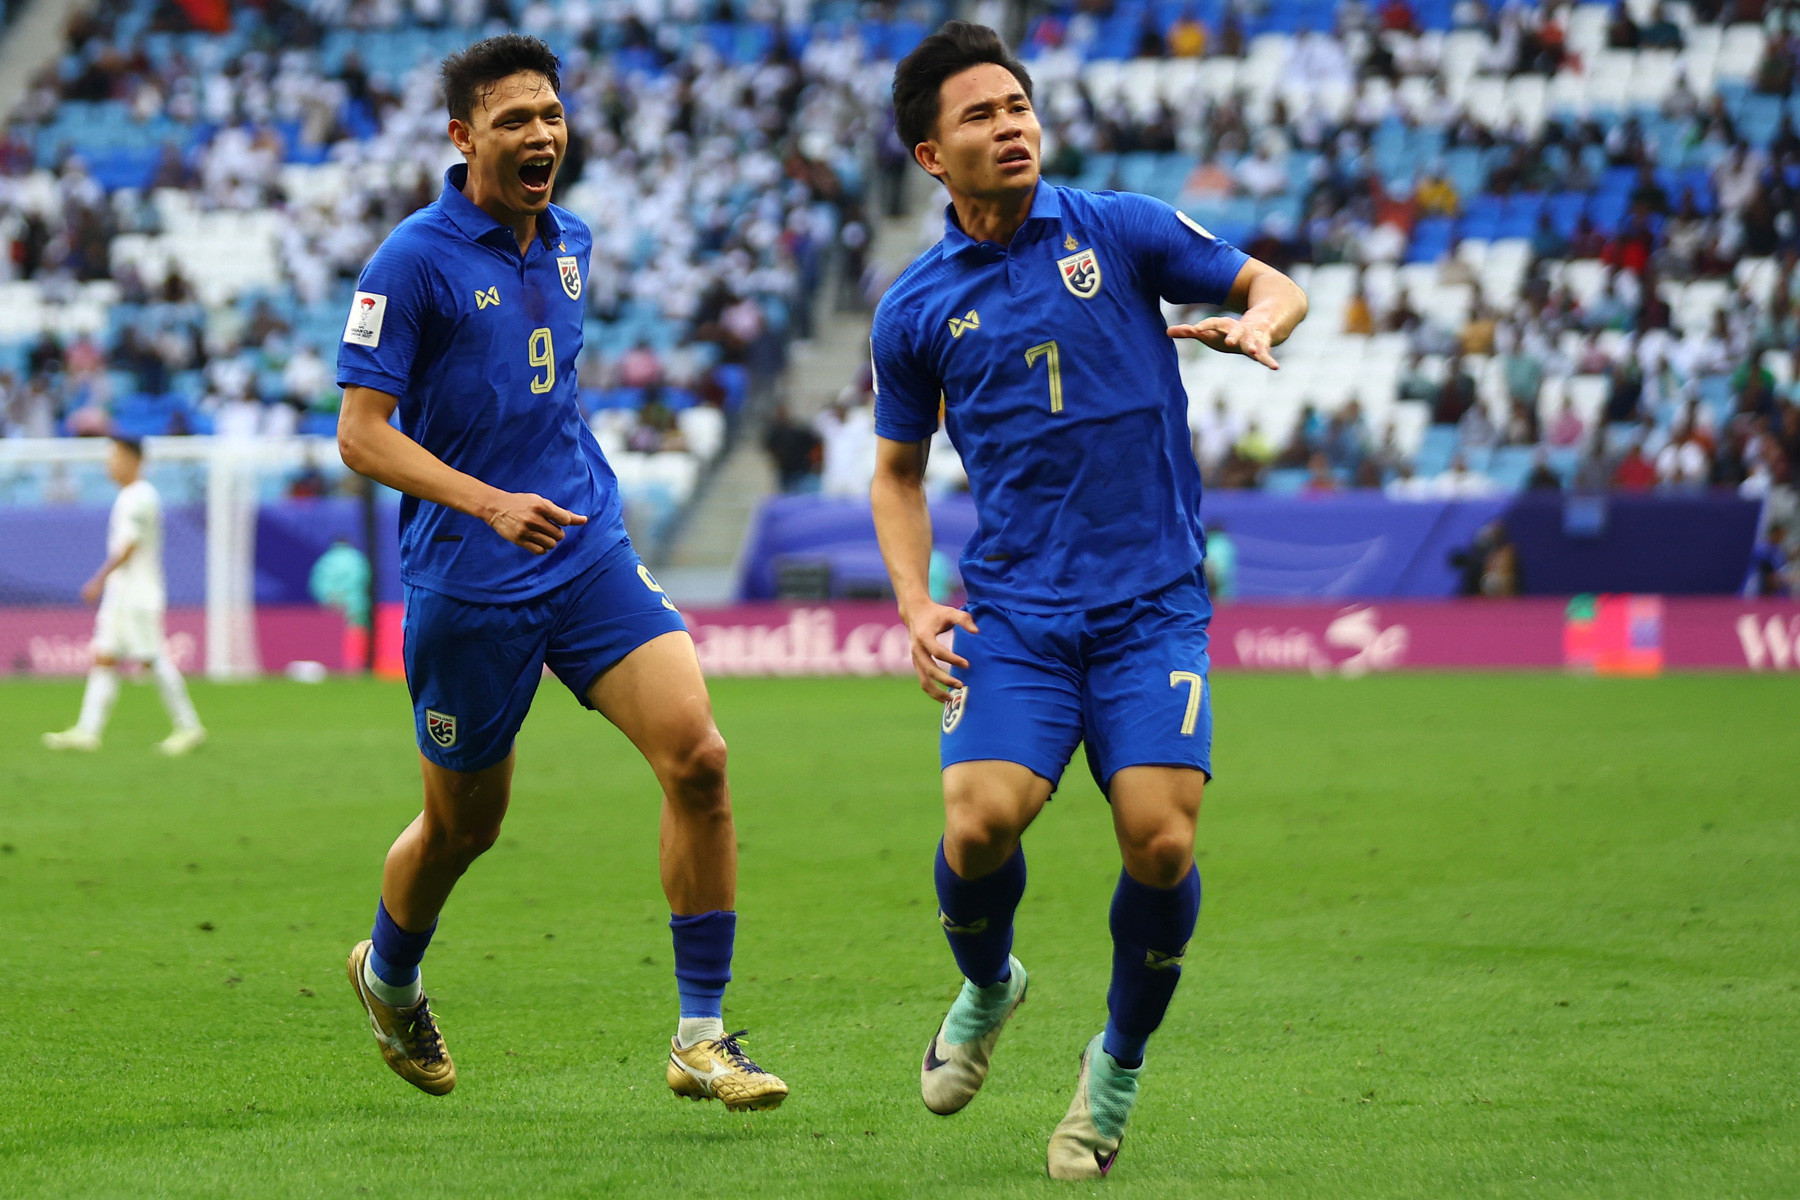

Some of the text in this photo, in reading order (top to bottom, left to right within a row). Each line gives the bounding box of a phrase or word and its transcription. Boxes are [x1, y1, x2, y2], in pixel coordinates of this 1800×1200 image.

[528, 327, 556, 395] 9
[1024, 339, 1064, 413] 7
[1735, 613, 1800, 672] W
[1169, 670, 1202, 736] 7
